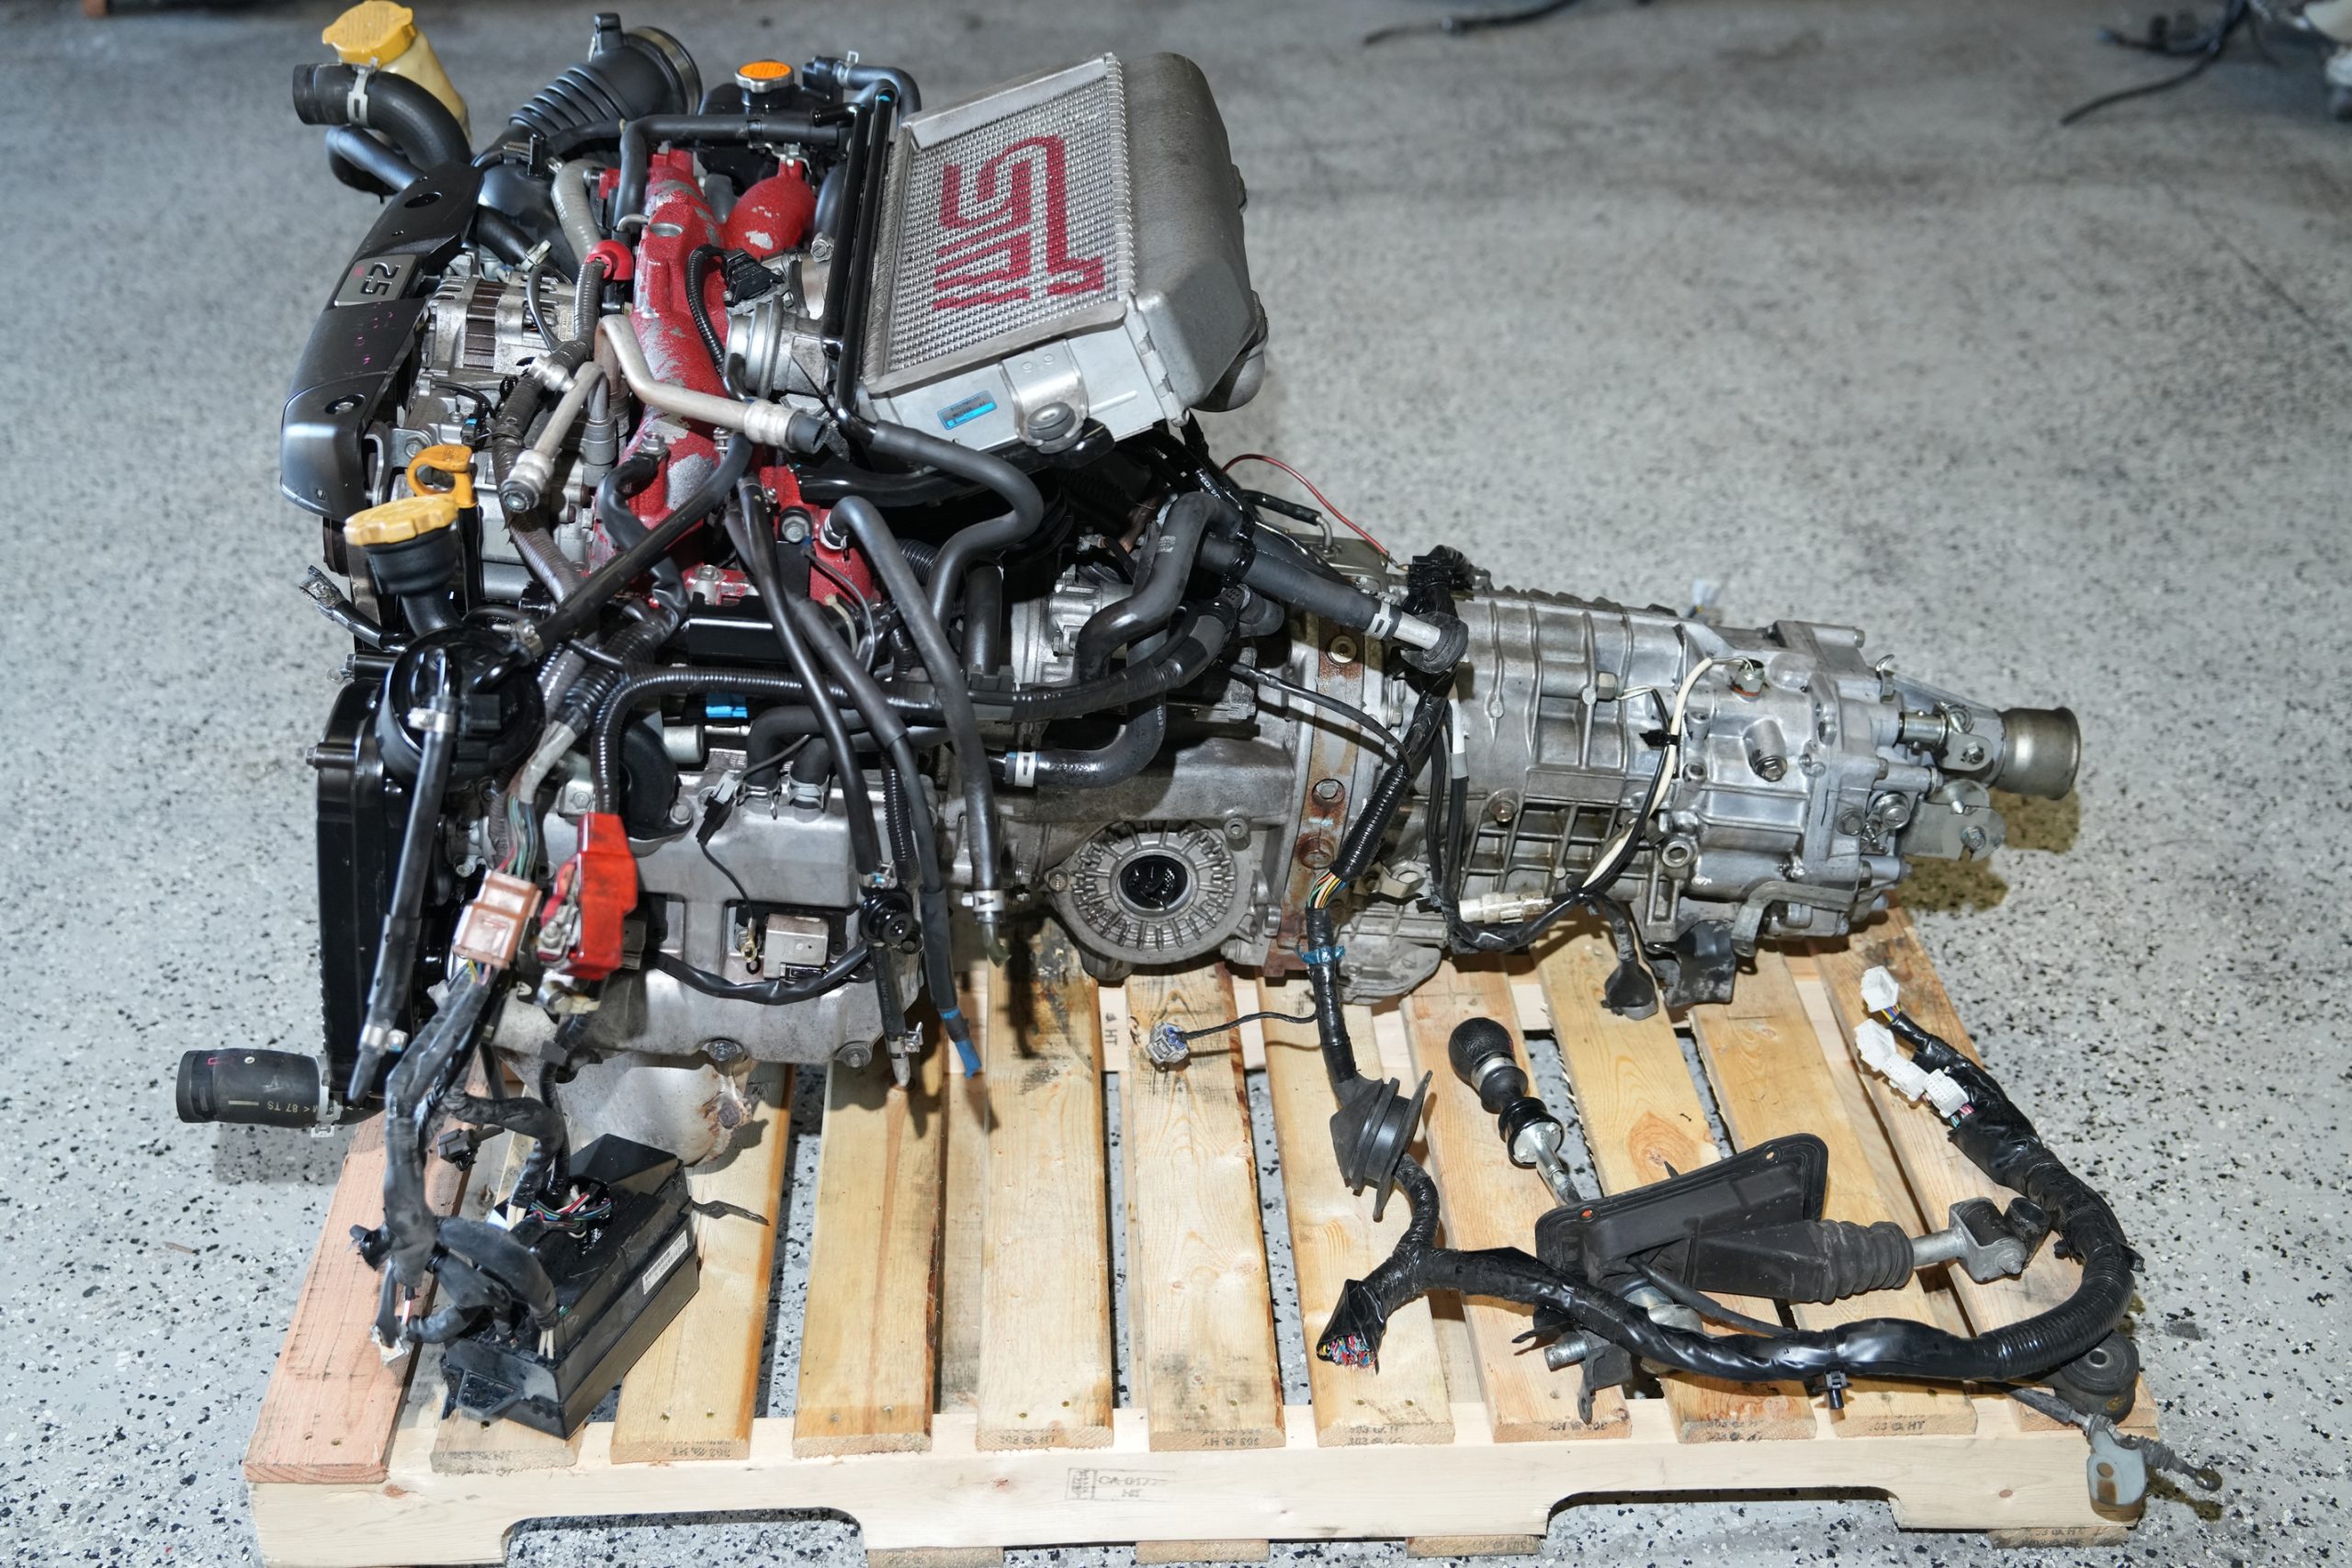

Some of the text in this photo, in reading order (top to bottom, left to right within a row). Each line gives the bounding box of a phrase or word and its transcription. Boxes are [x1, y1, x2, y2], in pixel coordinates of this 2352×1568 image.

[1104, 1029, 1117, 1045] HT
[266, 1100, 281, 1111] TS
[286, 1102, 299, 1112] 87
